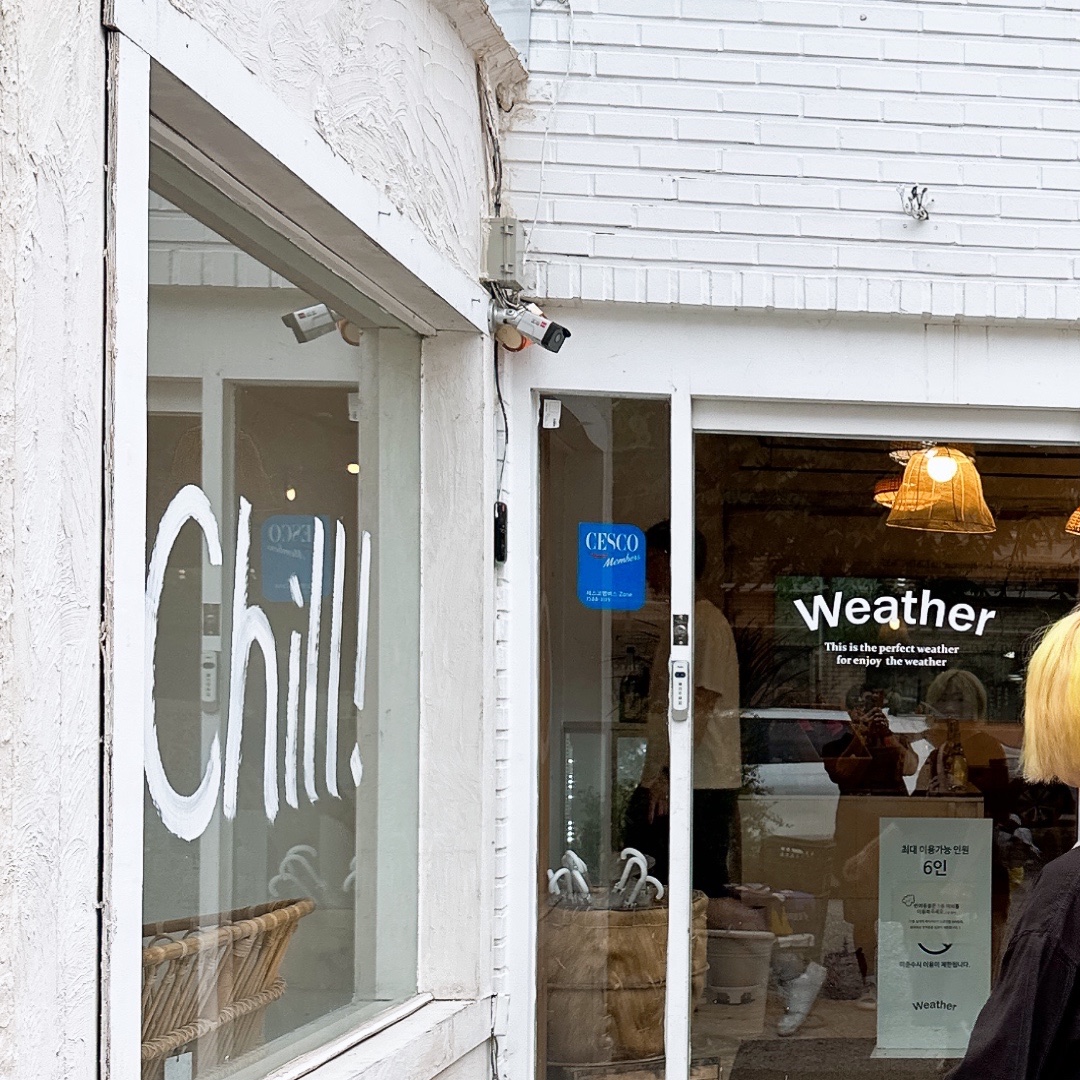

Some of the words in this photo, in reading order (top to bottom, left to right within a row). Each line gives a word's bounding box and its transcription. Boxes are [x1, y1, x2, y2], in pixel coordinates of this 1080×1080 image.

[586, 531, 639, 552] CESCO
[602, 553, 641, 568] Members
[793, 589, 996, 637] Weather
[824, 641, 848, 652] This
[848, 642, 859, 652] is
[860, 642, 878, 653] the
[878, 643, 915, 655] perfect
[917, 644, 960, 654] weather
[143, 484, 372, 842] Chill!
[836, 655, 852, 665] for
[853, 656, 882, 668] enjoy
[885, 656, 903, 666] the
[904, 657, 948, 667] weather
[901, 844, 918, 855] 최대
[953, 845, 970, 855] 인원
[923, 859, 947, 876] 6인
[912, 1000, 957, 1012] Weather
